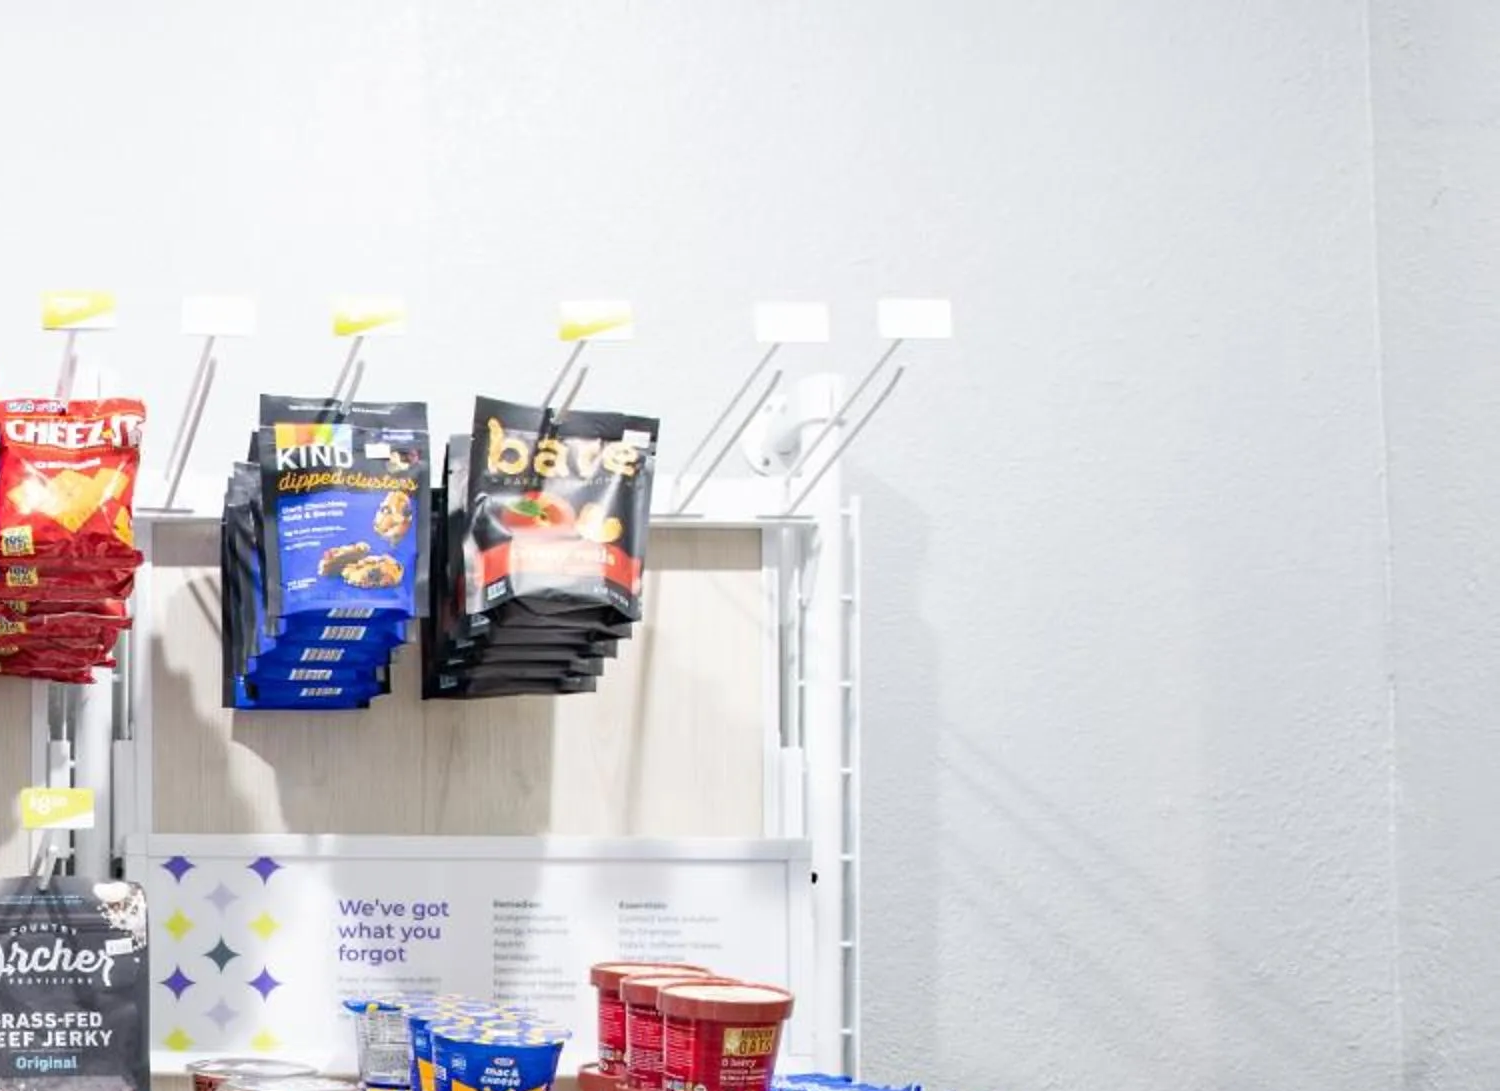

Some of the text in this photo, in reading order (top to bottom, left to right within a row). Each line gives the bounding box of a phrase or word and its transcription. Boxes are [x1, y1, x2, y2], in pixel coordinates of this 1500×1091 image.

[275, 444, 354, 471] KIND
[278, 472, 344, 492] dipped
[337, 898, 450, 921] We've got
[337, 922, 442, 943] what you
[337, 943, 409, 966] forgot
[41, 1029, 113, 1048] JERKY
[739, 1038, 772, 1055] OATS
[15, 1055, 78, 1072] Original
